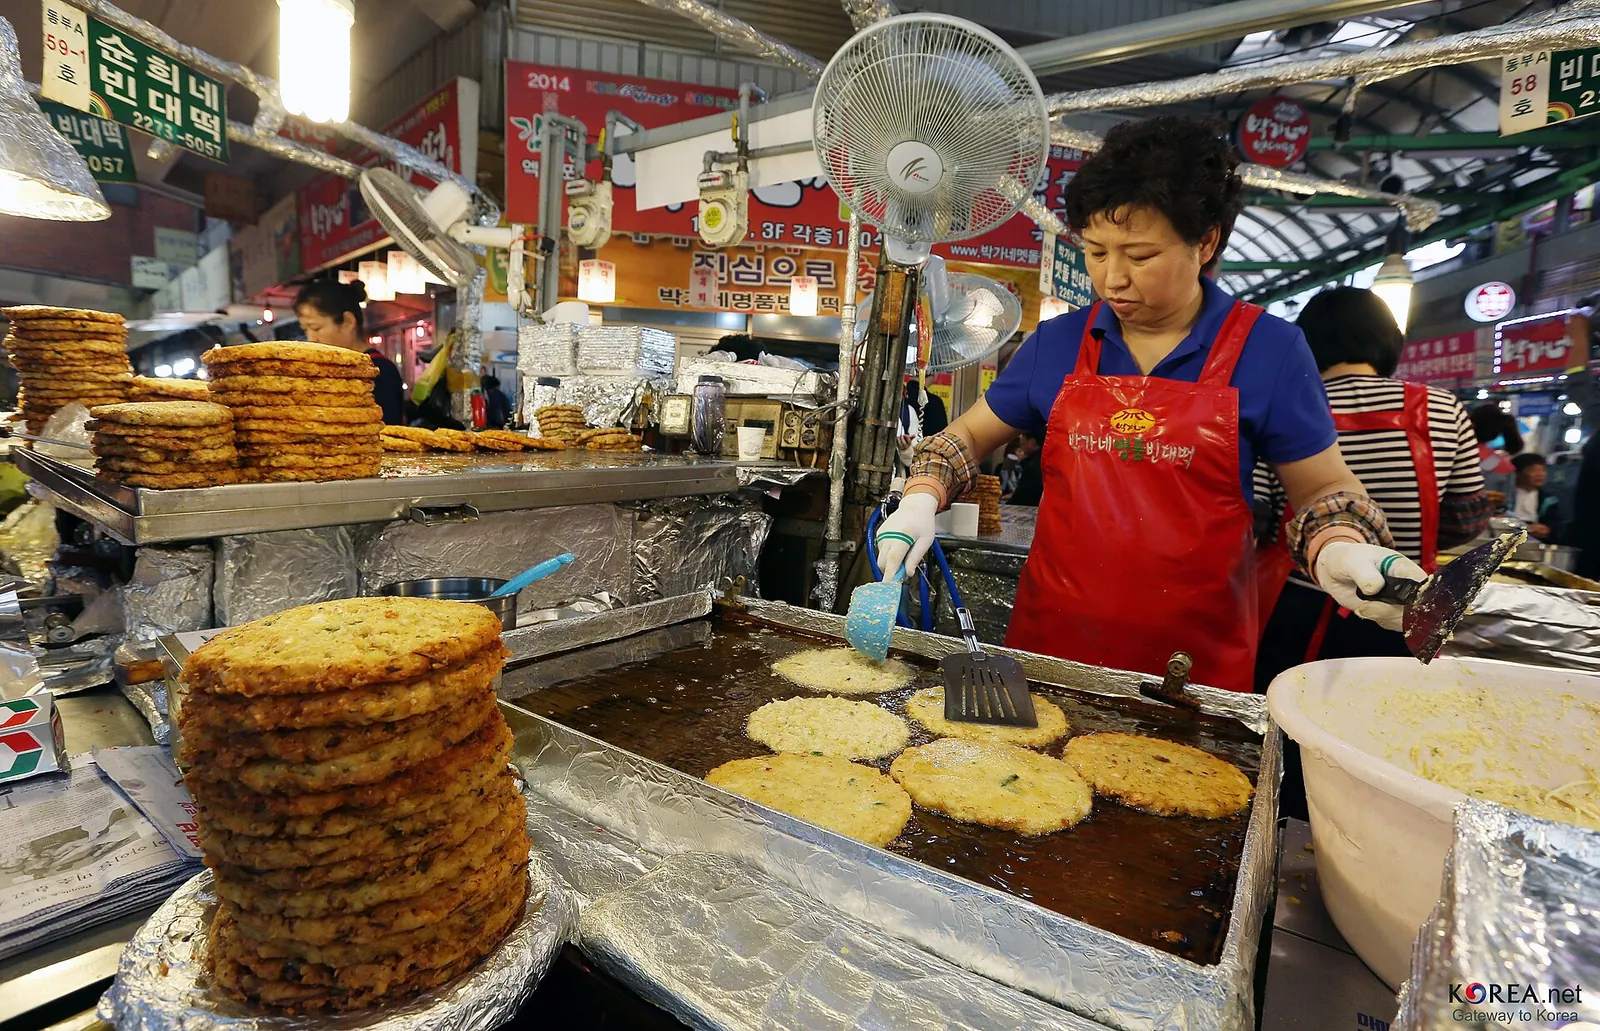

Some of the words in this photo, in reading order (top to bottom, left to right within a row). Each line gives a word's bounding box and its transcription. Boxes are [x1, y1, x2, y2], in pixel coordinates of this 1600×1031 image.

[47, 8, 84, 37] 동부A
[45, 34, 86, 64] 59-1
[1505, 51, 1549, 72] 동부A
[57, 61, 78, 86] 호
[95, 33, 220, 112] 순희네
[527, 72, 571, 91] 2014
[1510, 74, 1537, 95] 58
[99, 63, 221, 142] 빈대떡
[1510, 98, 1535, 118] 호
[132, 110, 222, 159] 2273-5057
[762, 222, 785, 240] 3F
[693, 252, 835, 287] 진심으로
[659, 288, 840, 313] 박네명품빈떡
